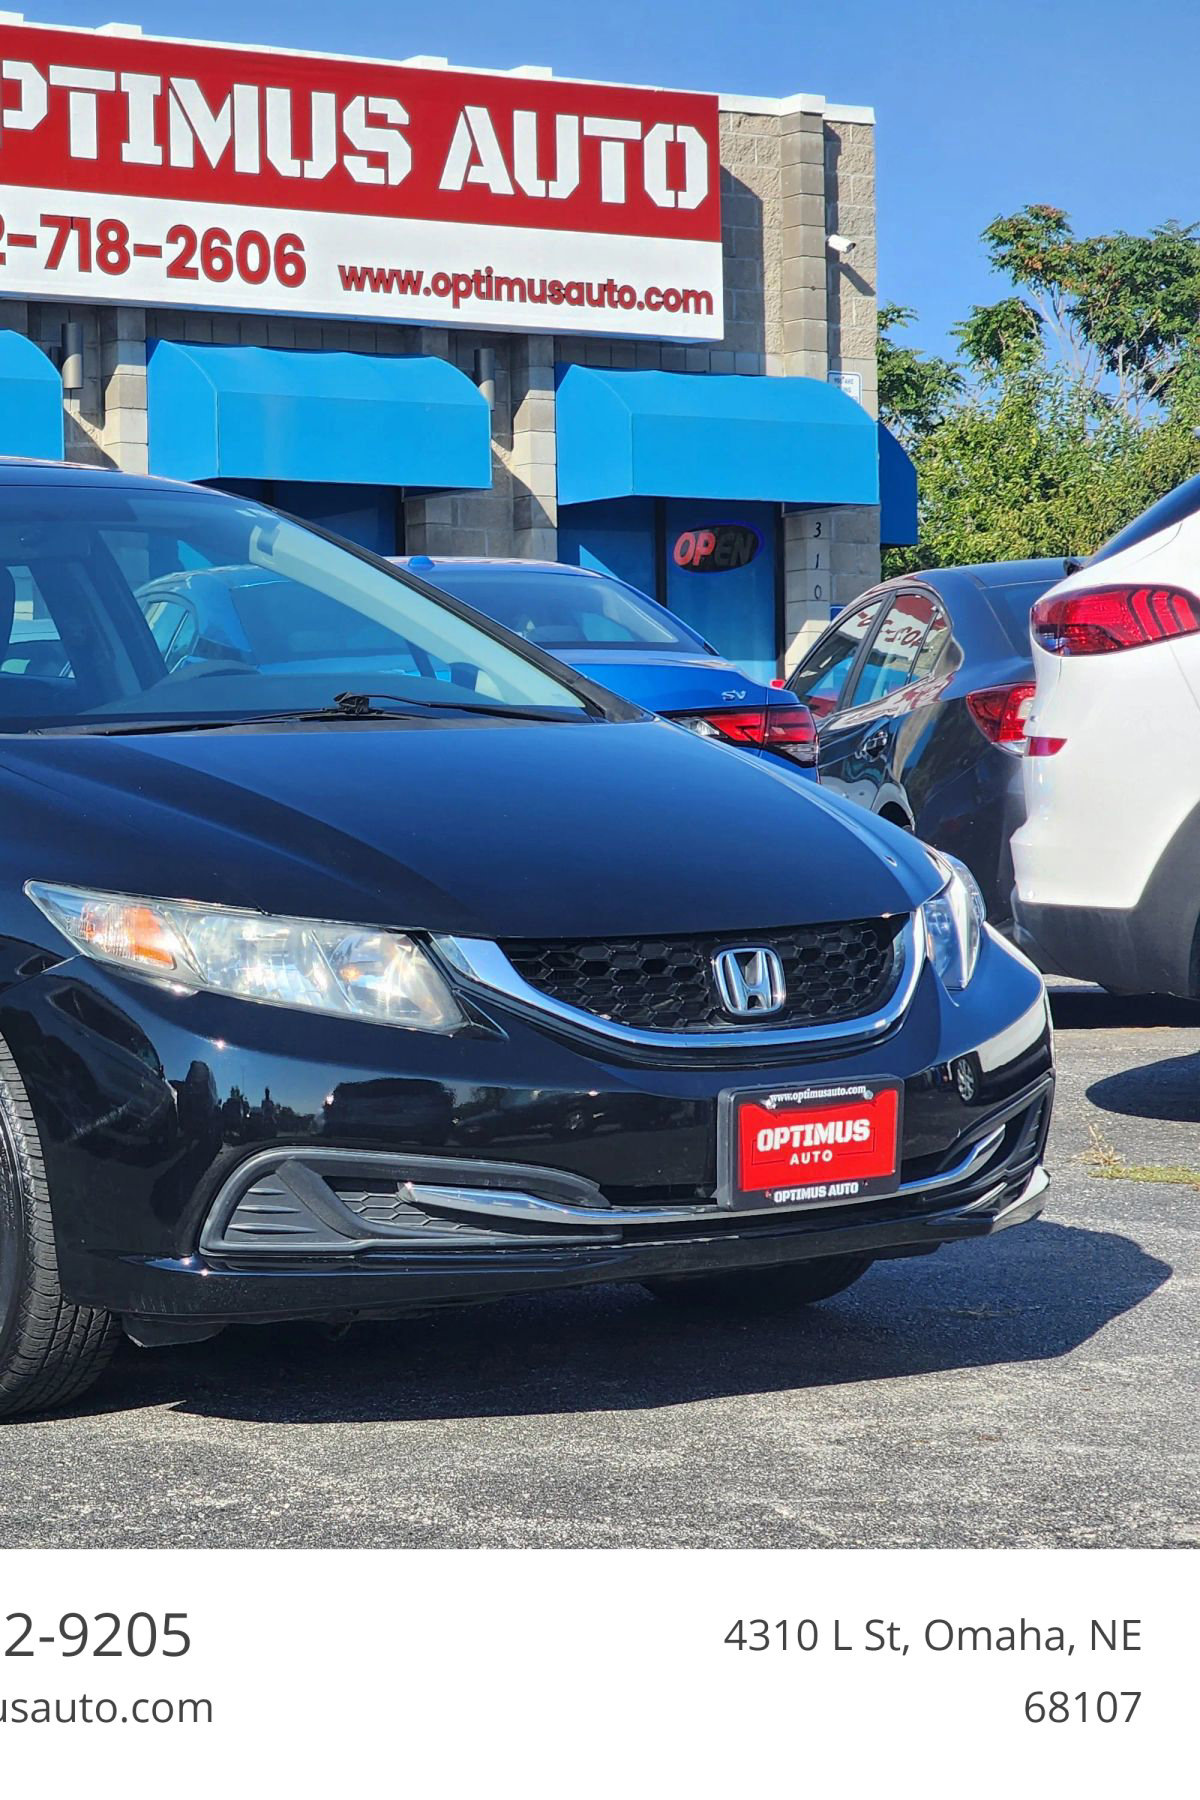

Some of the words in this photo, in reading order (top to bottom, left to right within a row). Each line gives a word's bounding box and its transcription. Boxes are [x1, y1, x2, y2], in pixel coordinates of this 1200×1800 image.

[438, 105, 710, 211] AUTO
[338, 265, 714, 317] www.optimusauto.com
[673, 530, 754, 567] OPEN
[721, 690, 746, 701] SV
[769, 1085, 866, 1103] www.optimusauto.com
[757, 1119, 870, 1152] OPTIMUS
[789, 1150, 833, 1166] AUTO
[773, 1185, 827, 1203] OPTIMUS
[827, 1182, 859, 1196] AUTO
